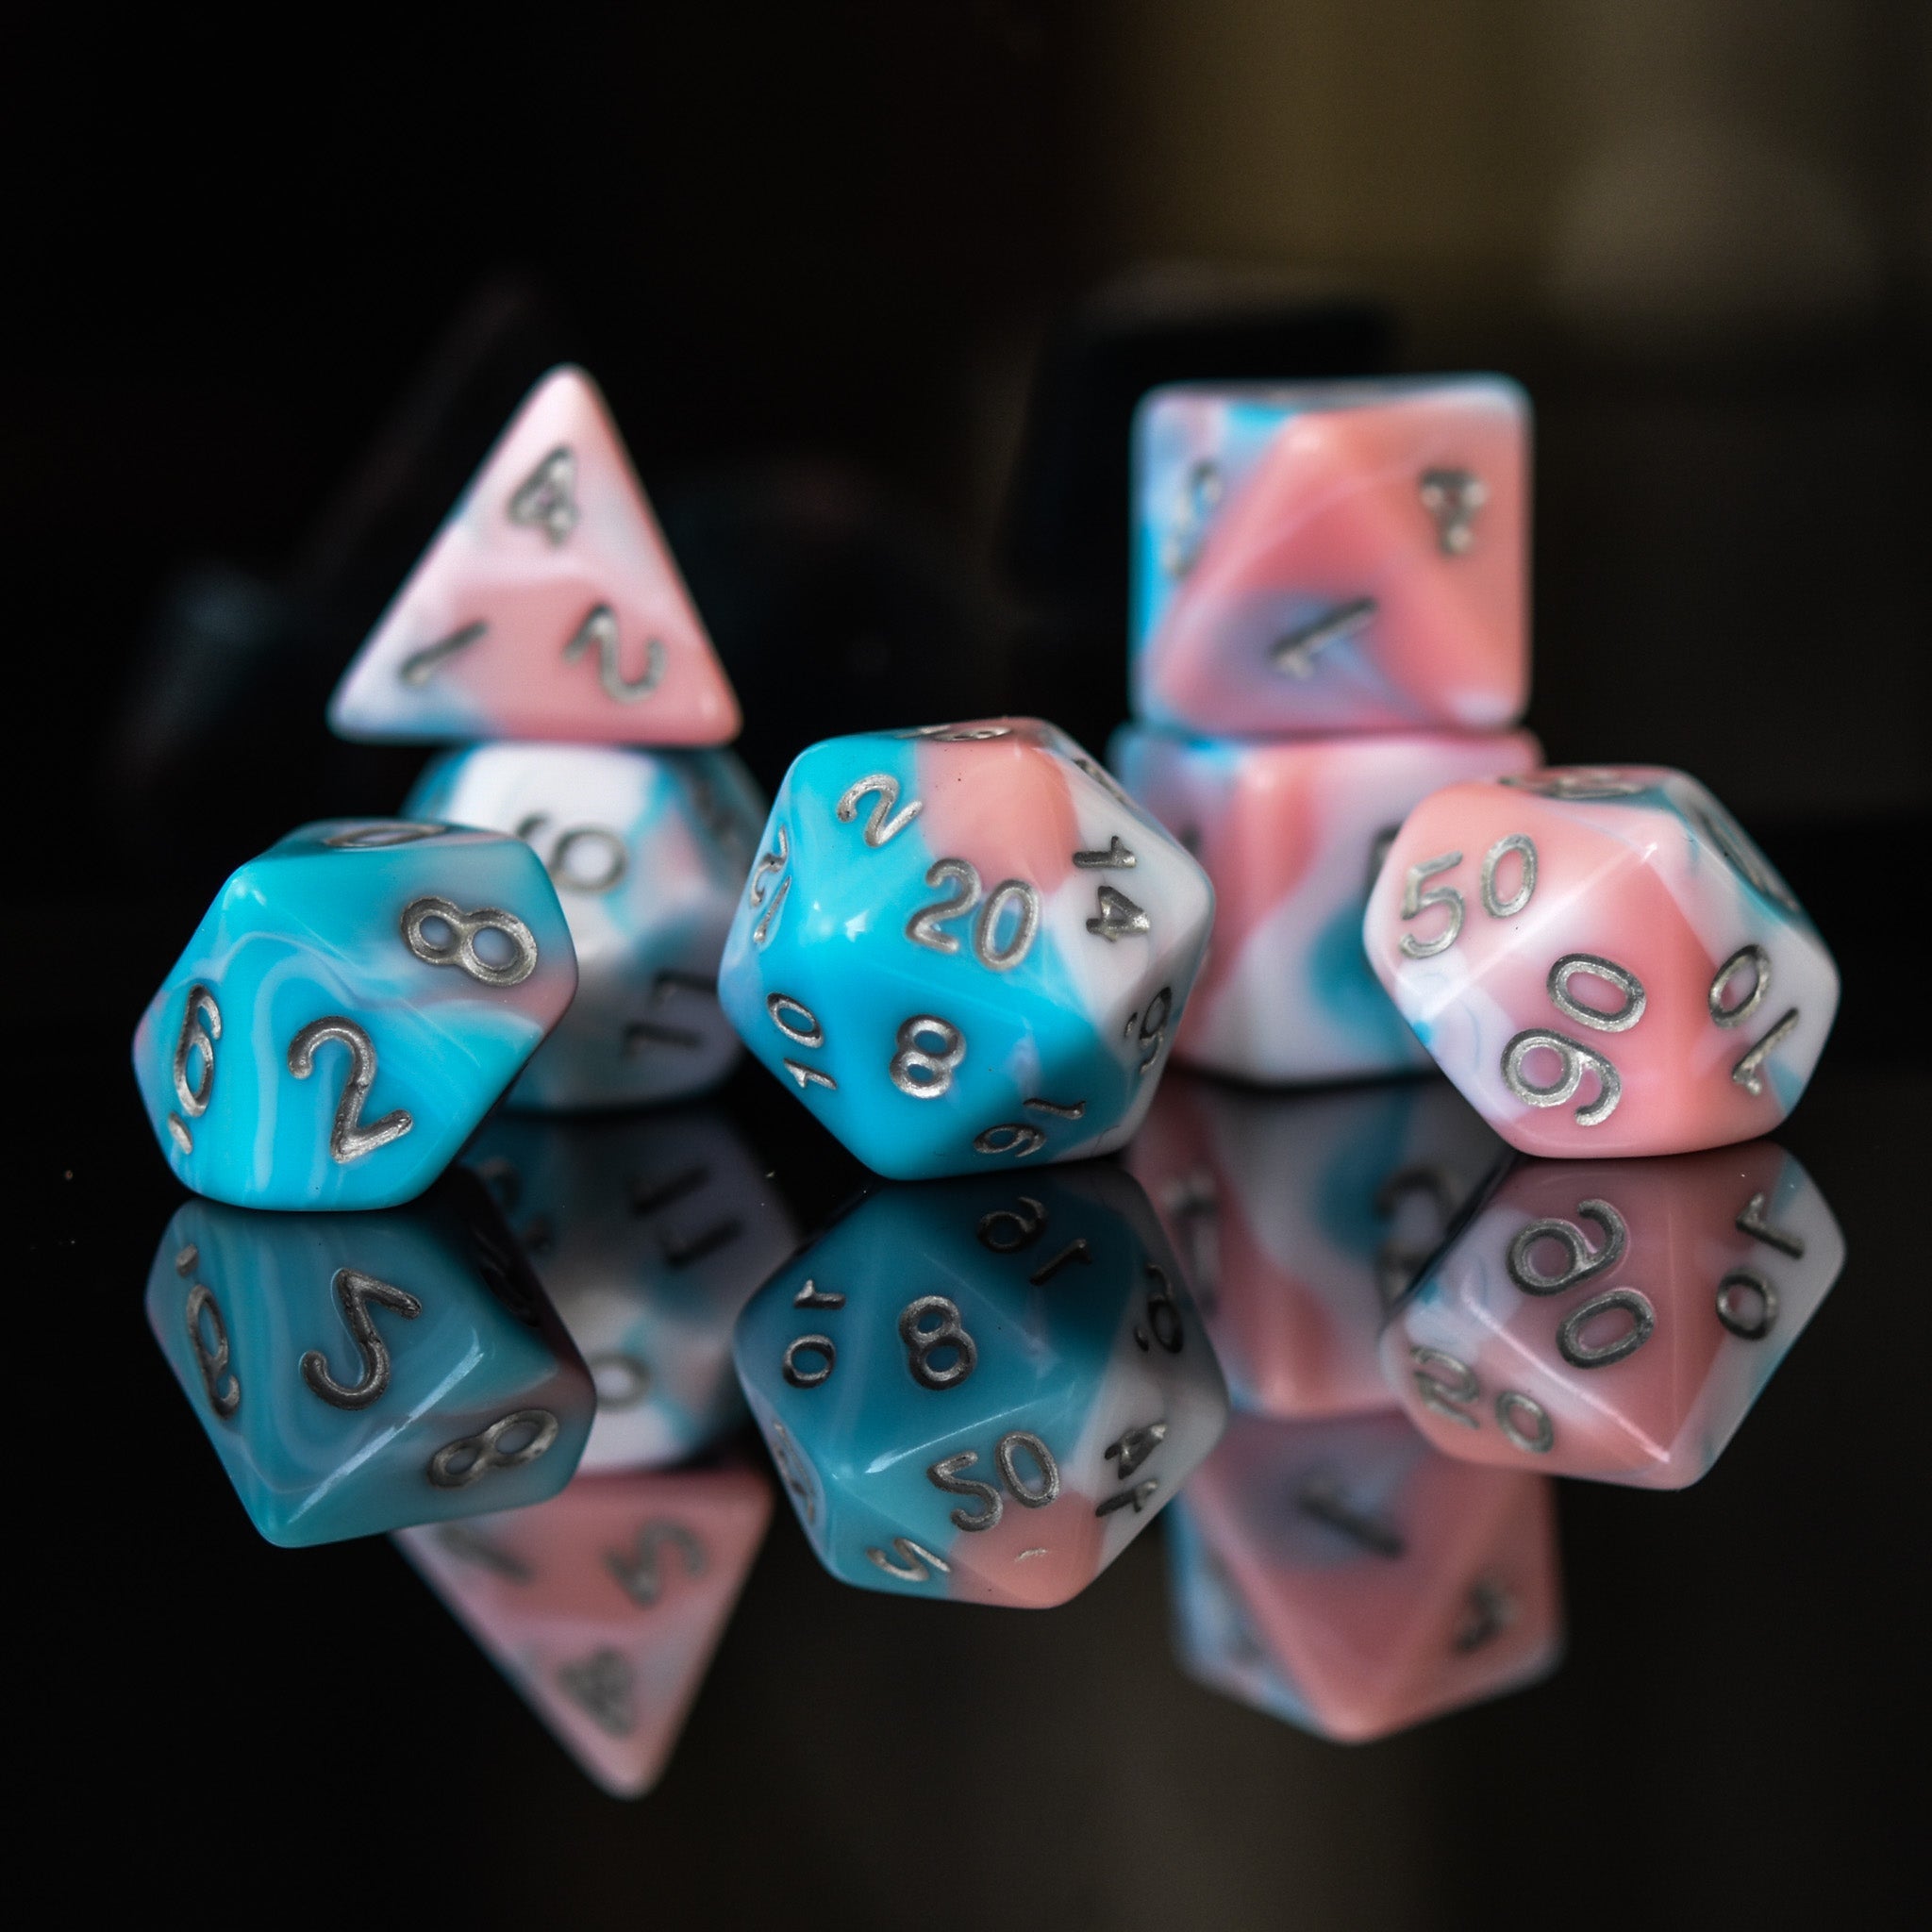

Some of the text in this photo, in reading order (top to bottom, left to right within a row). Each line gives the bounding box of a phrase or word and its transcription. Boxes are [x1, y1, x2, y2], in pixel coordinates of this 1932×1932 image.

[836, 774, 923, 848] 2
[399, 894, 539, 988] 8
[904, 857, 1041, 973] 20
[1073, 835, 1153, 943] 14
[1400, 833, 1539, 959] 50
[766, 991, 838, 1091] 10
[889, 1014, 968, 1100] 8
[1500, 953, 1647, 1127] 90
[1708, 944, 1800, 1097] 10
[287, 1015, 414, 1164] 2
